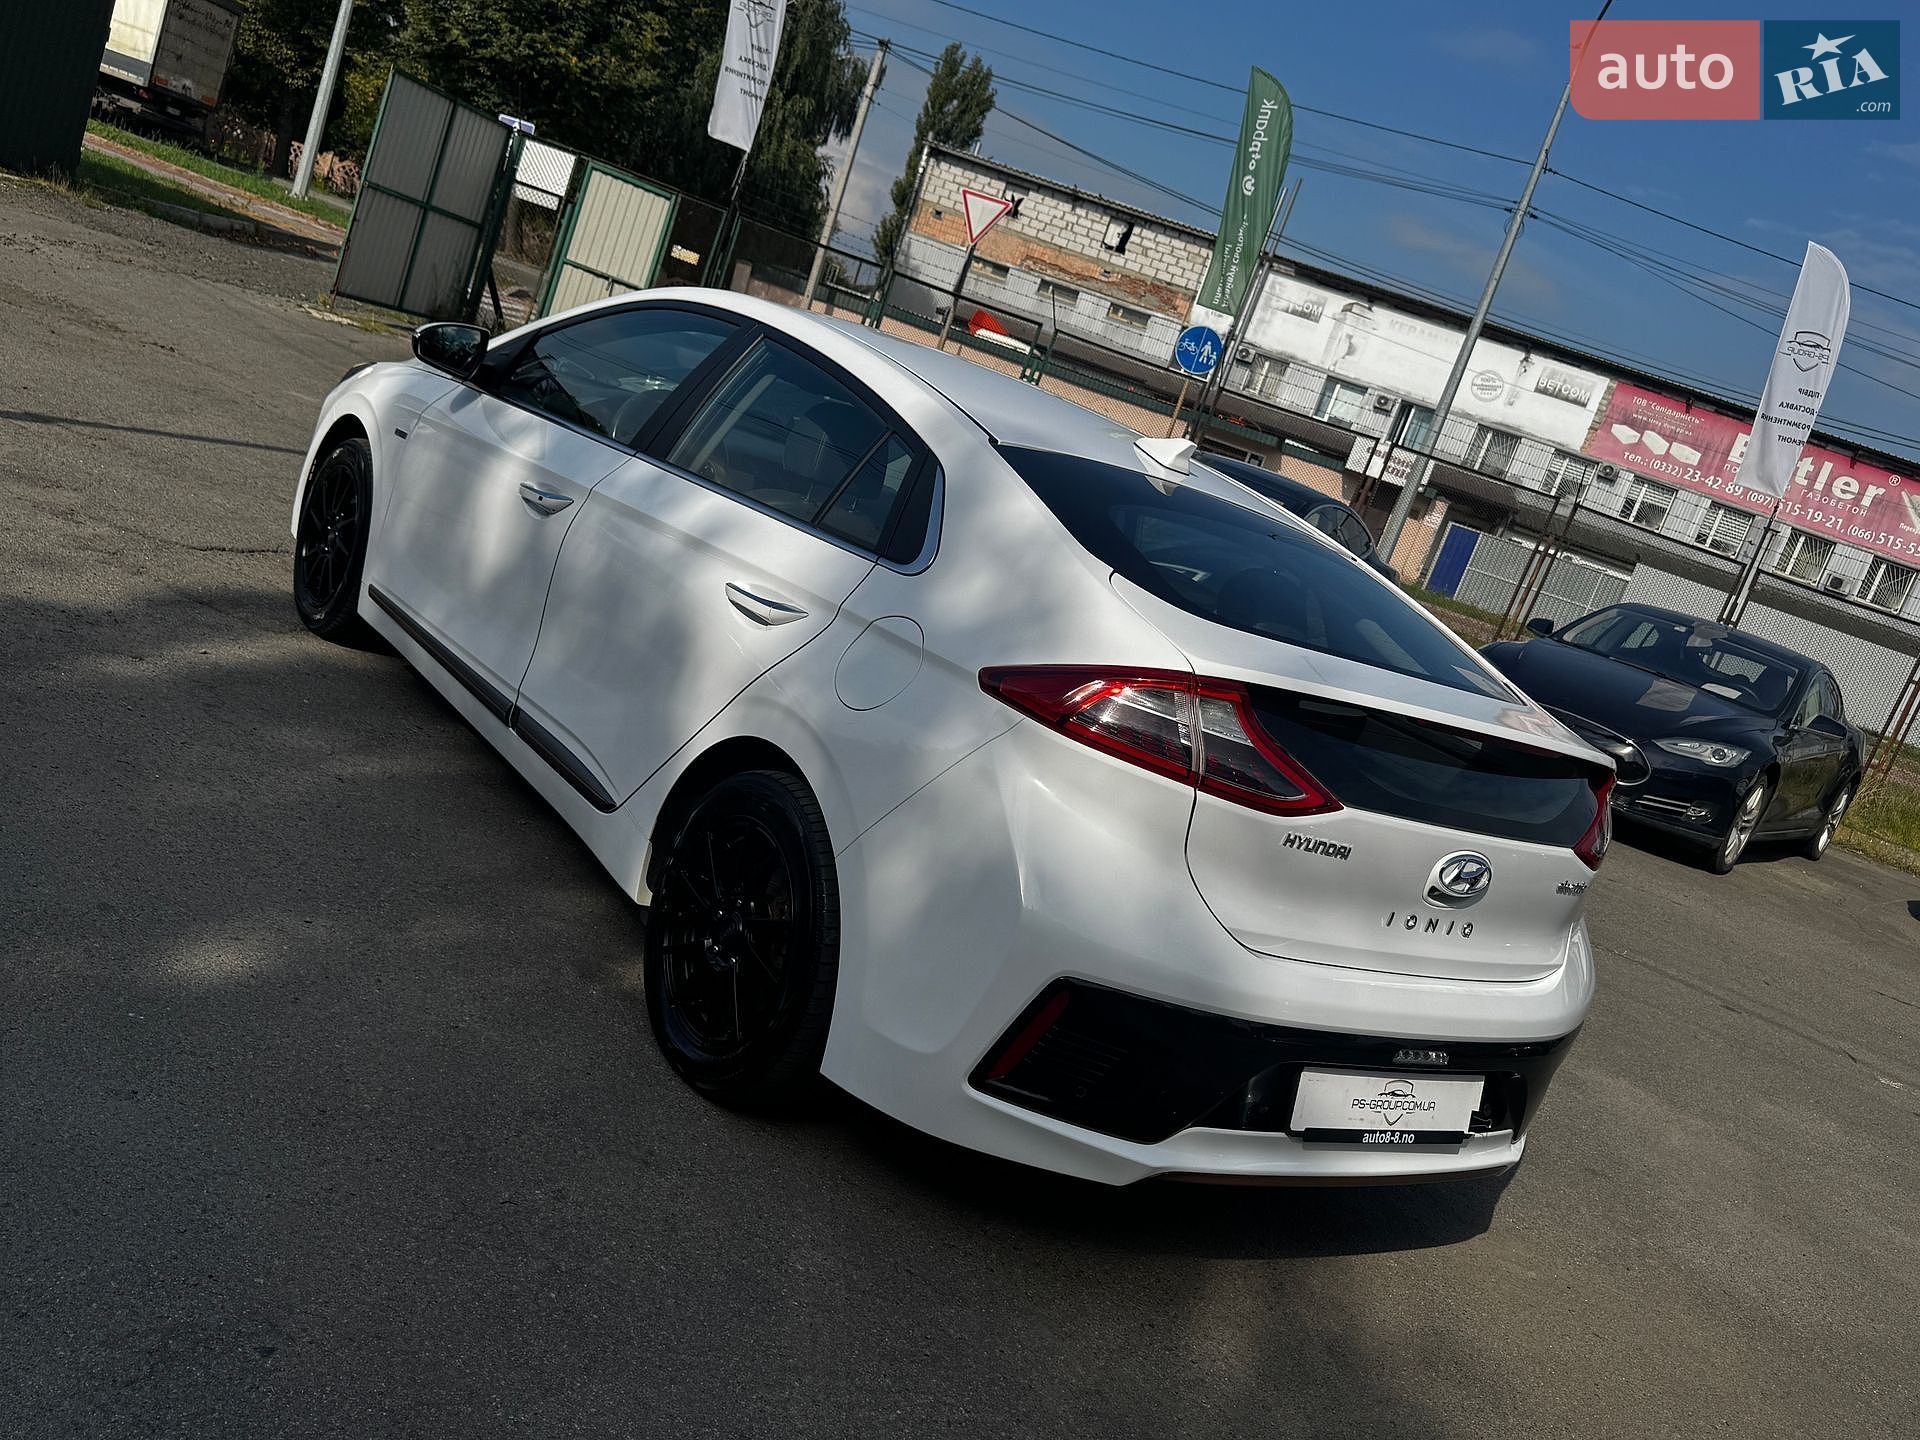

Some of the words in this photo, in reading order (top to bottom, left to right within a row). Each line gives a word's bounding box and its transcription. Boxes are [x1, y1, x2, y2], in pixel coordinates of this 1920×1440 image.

[1649, 458, 1683, 478] (0332)
[1746, 490, 1775, 509] (097)
[1847, 524, 1876, 543] (066)
[1800, 489, 1868, 517] ГАЗОБЕТОН
[1282, 833, 1352, 860] HYUNDAI
[1386, 911, 1475, 938] IONIQ
[1362, 1131, 1415, 1144] auto8-8.no
